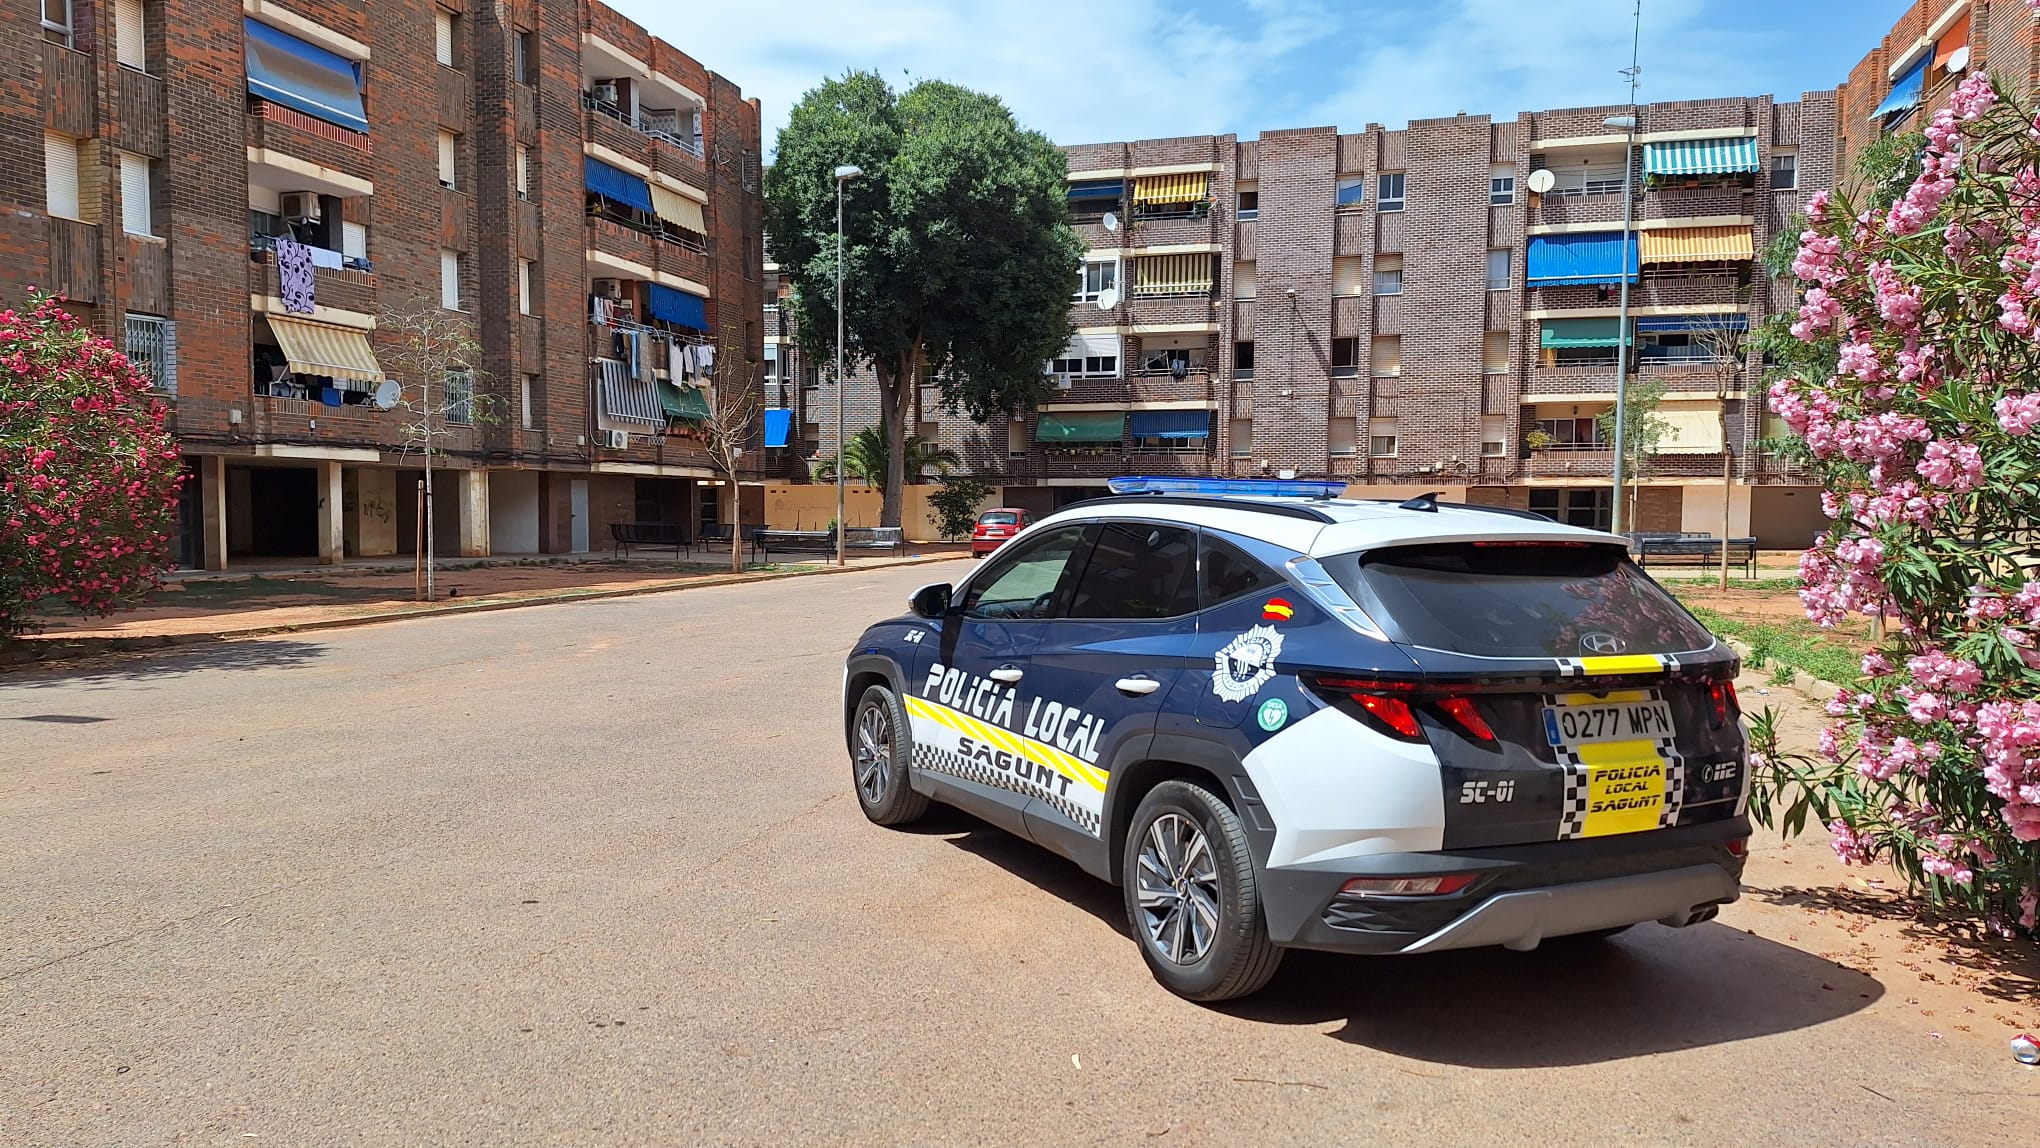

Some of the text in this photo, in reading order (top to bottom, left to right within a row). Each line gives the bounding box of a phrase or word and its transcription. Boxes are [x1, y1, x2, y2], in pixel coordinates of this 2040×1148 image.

[922, 662, 1105, 764] POLICIA LOCAL
[1562, 705, 1669, 738] 0277 MPN
[957, 737, 1074, 797] SAGUNT
[1594, 765, 1660, 782] POLICIA
[1713, 761, 1737, 781] 112
[1460, 780, 1515, 803] SC-01
[1605, 781, 1649, 795] LOCAL
[1590, 795, 1661, 813] SAGUNT
